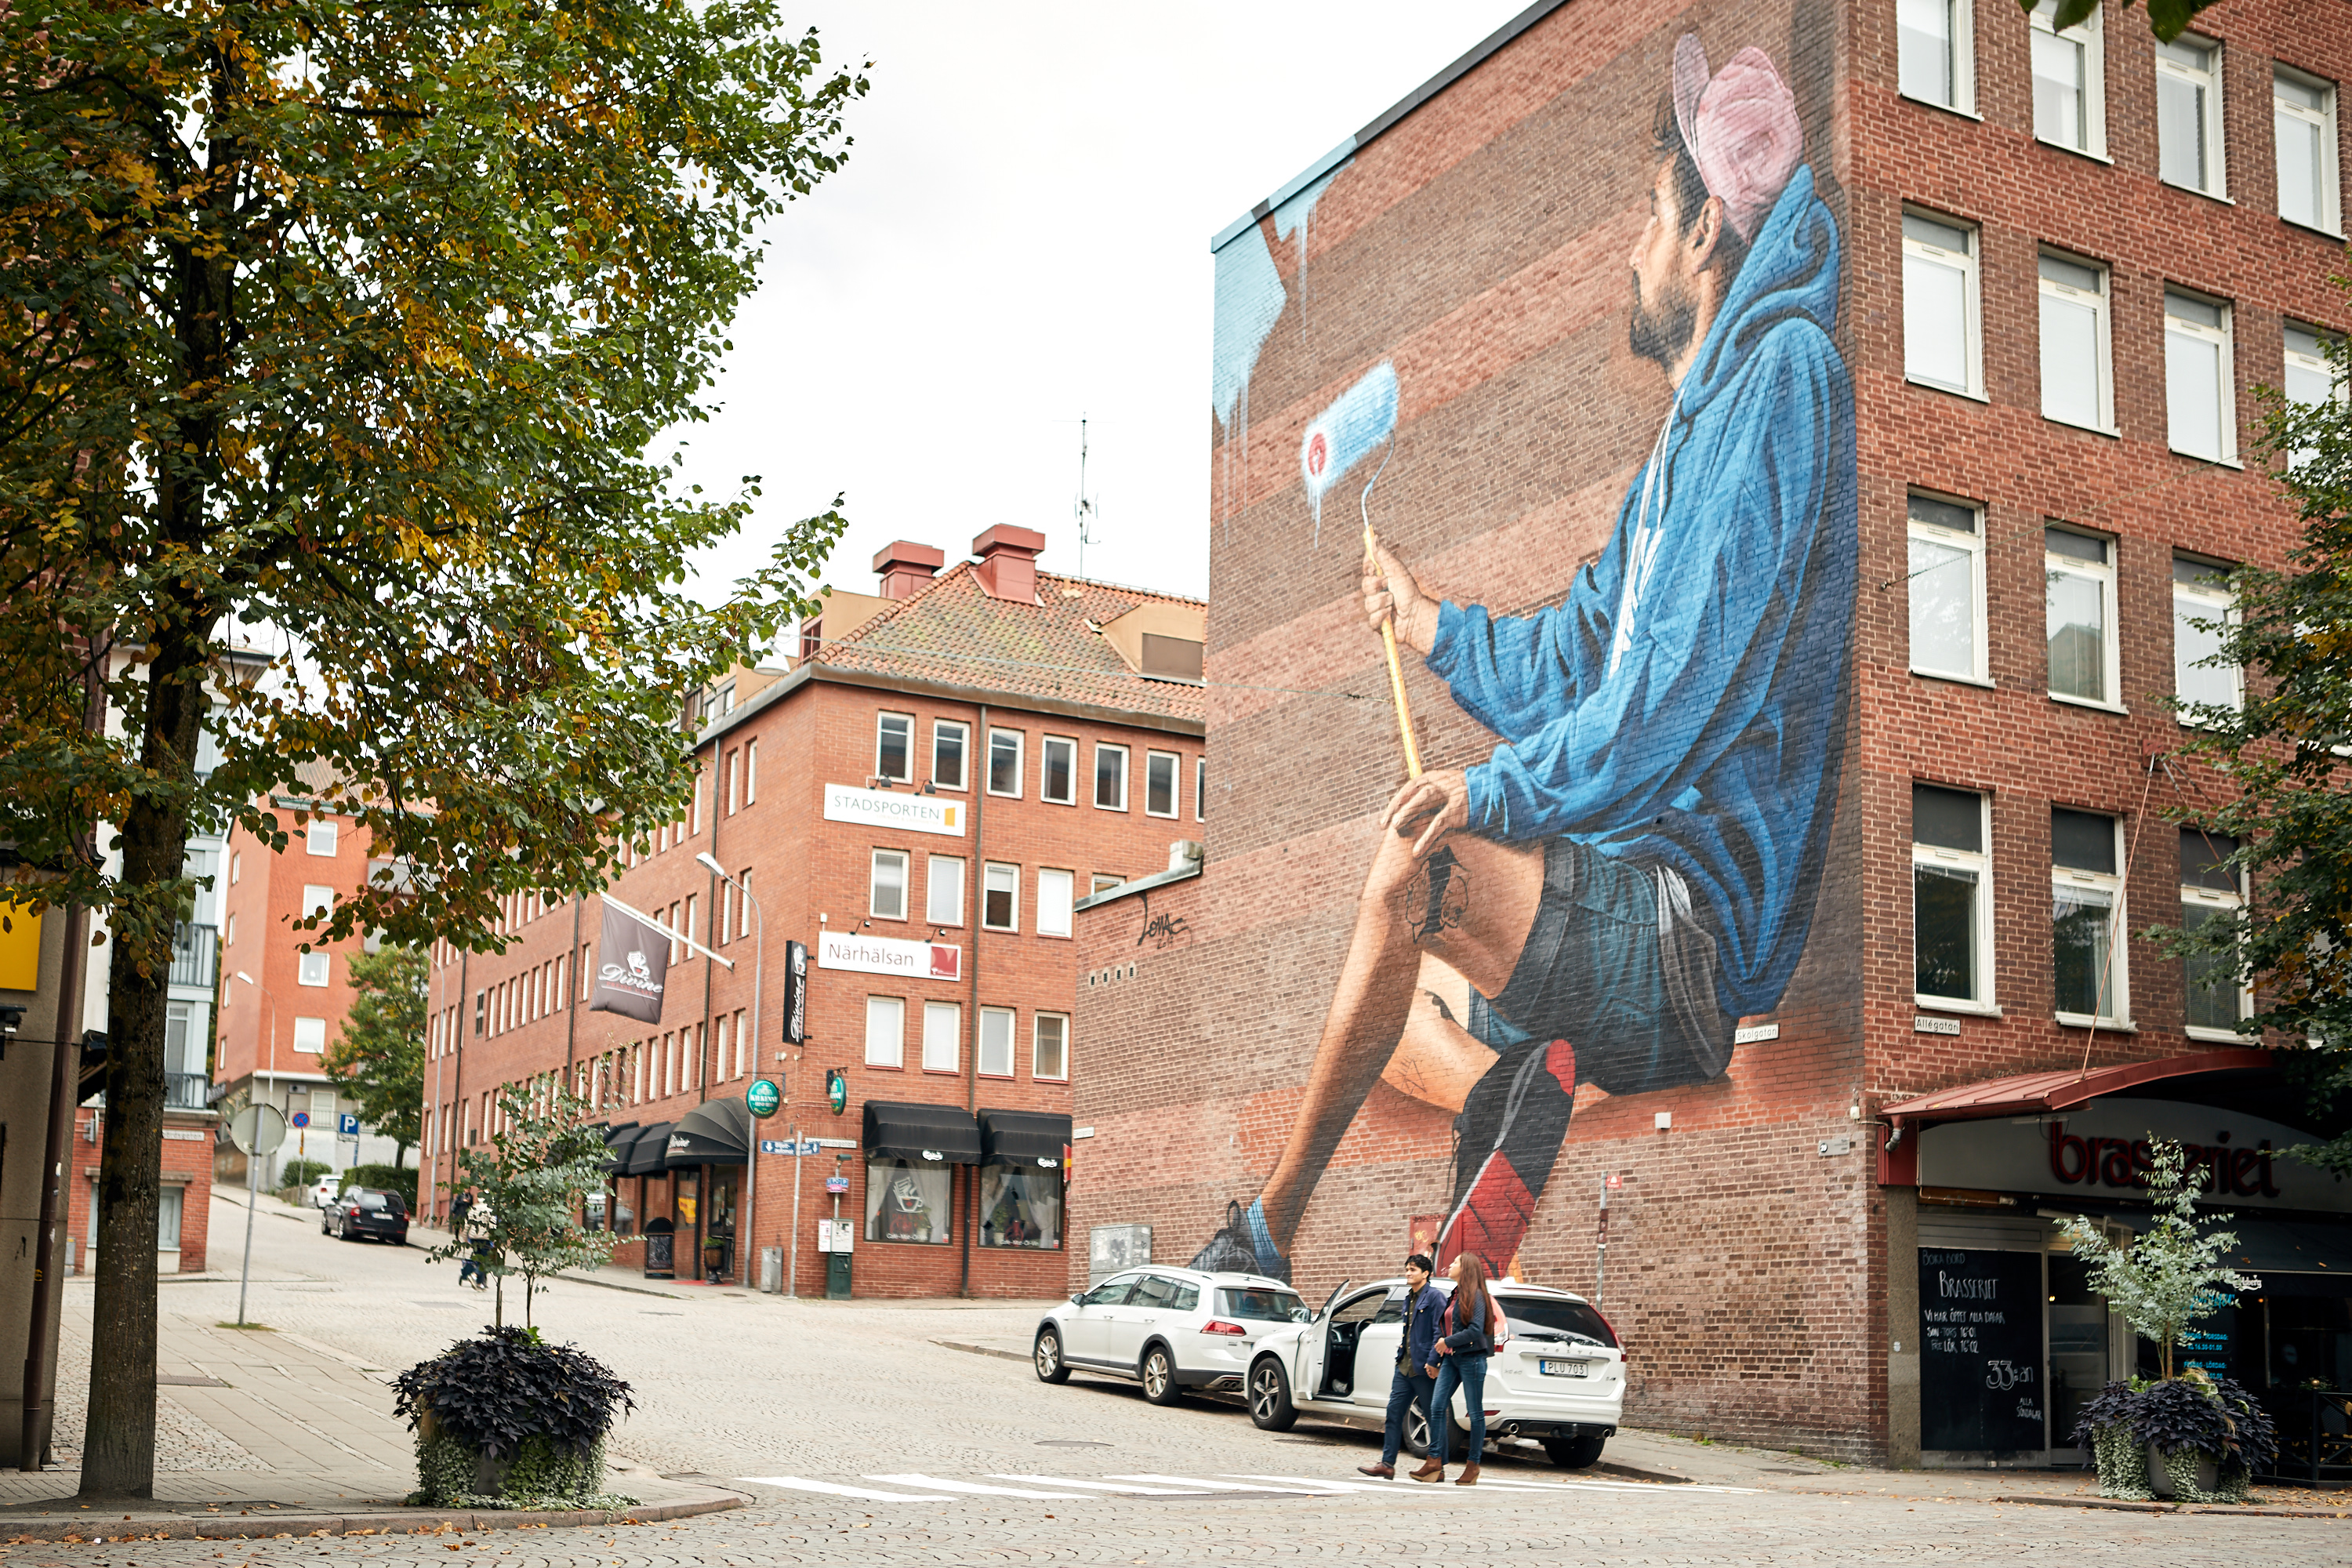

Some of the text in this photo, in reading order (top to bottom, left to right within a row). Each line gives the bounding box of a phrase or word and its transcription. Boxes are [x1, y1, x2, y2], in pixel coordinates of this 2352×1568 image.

[834, 795, 939, 820] STADSPORTEN
[828, 943, 914, 967] Närhälsan
[598, 963, 662, 993] Divine
[1916, 1018, 1958, 1032] Allégatan
[1737, 1028, 1777, 1040] Skolgatan
[344, 1116, 356, 1133] P
[2233, 1275, 2262, 1291] Clsberg
[1548, 1363, 1584, 1374] PLU 703
